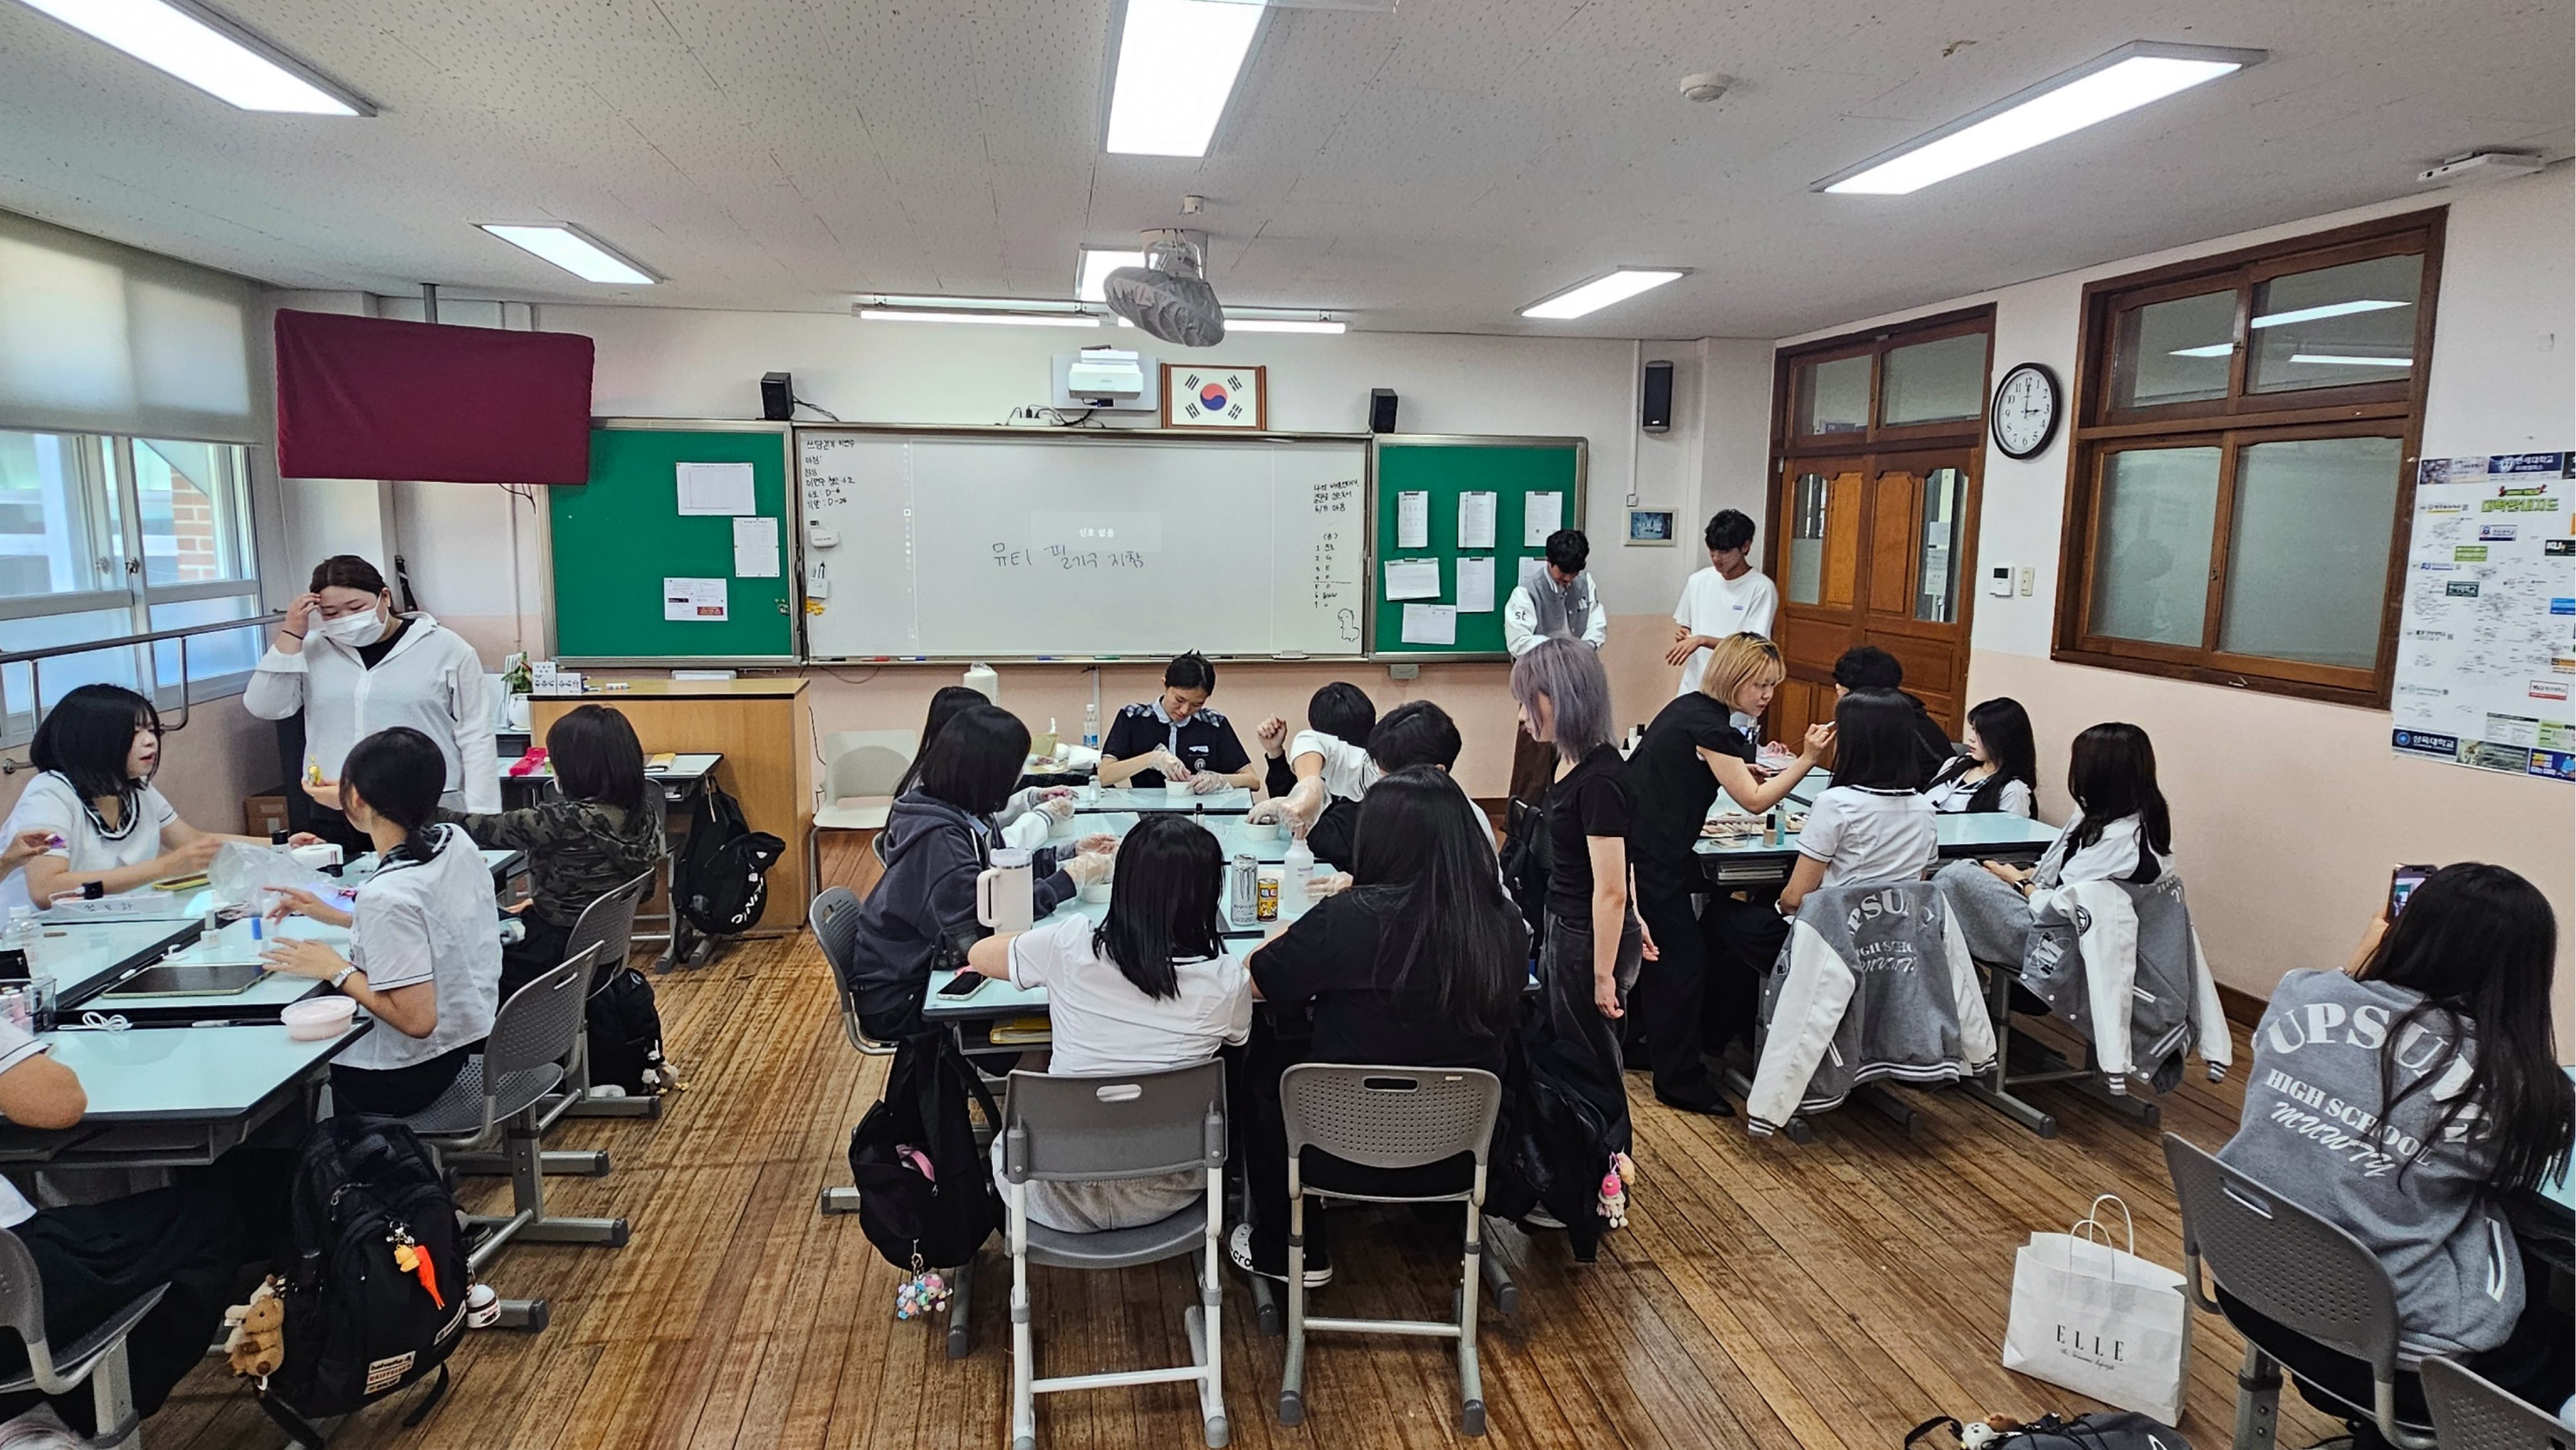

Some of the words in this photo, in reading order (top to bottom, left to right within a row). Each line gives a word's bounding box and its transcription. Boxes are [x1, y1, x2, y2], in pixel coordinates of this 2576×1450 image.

[2043, 388, 2048, 399] 2
[2007, 395, 2015, 404] 10
[2005, 409, 2011, 417] 9
[2043, 403, 2050, 414] 3
[2007, 422, 2012, 432] 8
[2039, 419, 2046, 429] 4
[2013, 433, 2018, 442] 7
[2032, 430, 2038, 441] 5
[2022, 436, 2028, 446] 6
[1079, 527, 1095, 537] 신호
[1098, 527, 1114, 537] 없음
[2265, 1068, 2327, 1110] HIGH
[2057, 1324, 2124, 1361] ELLE
